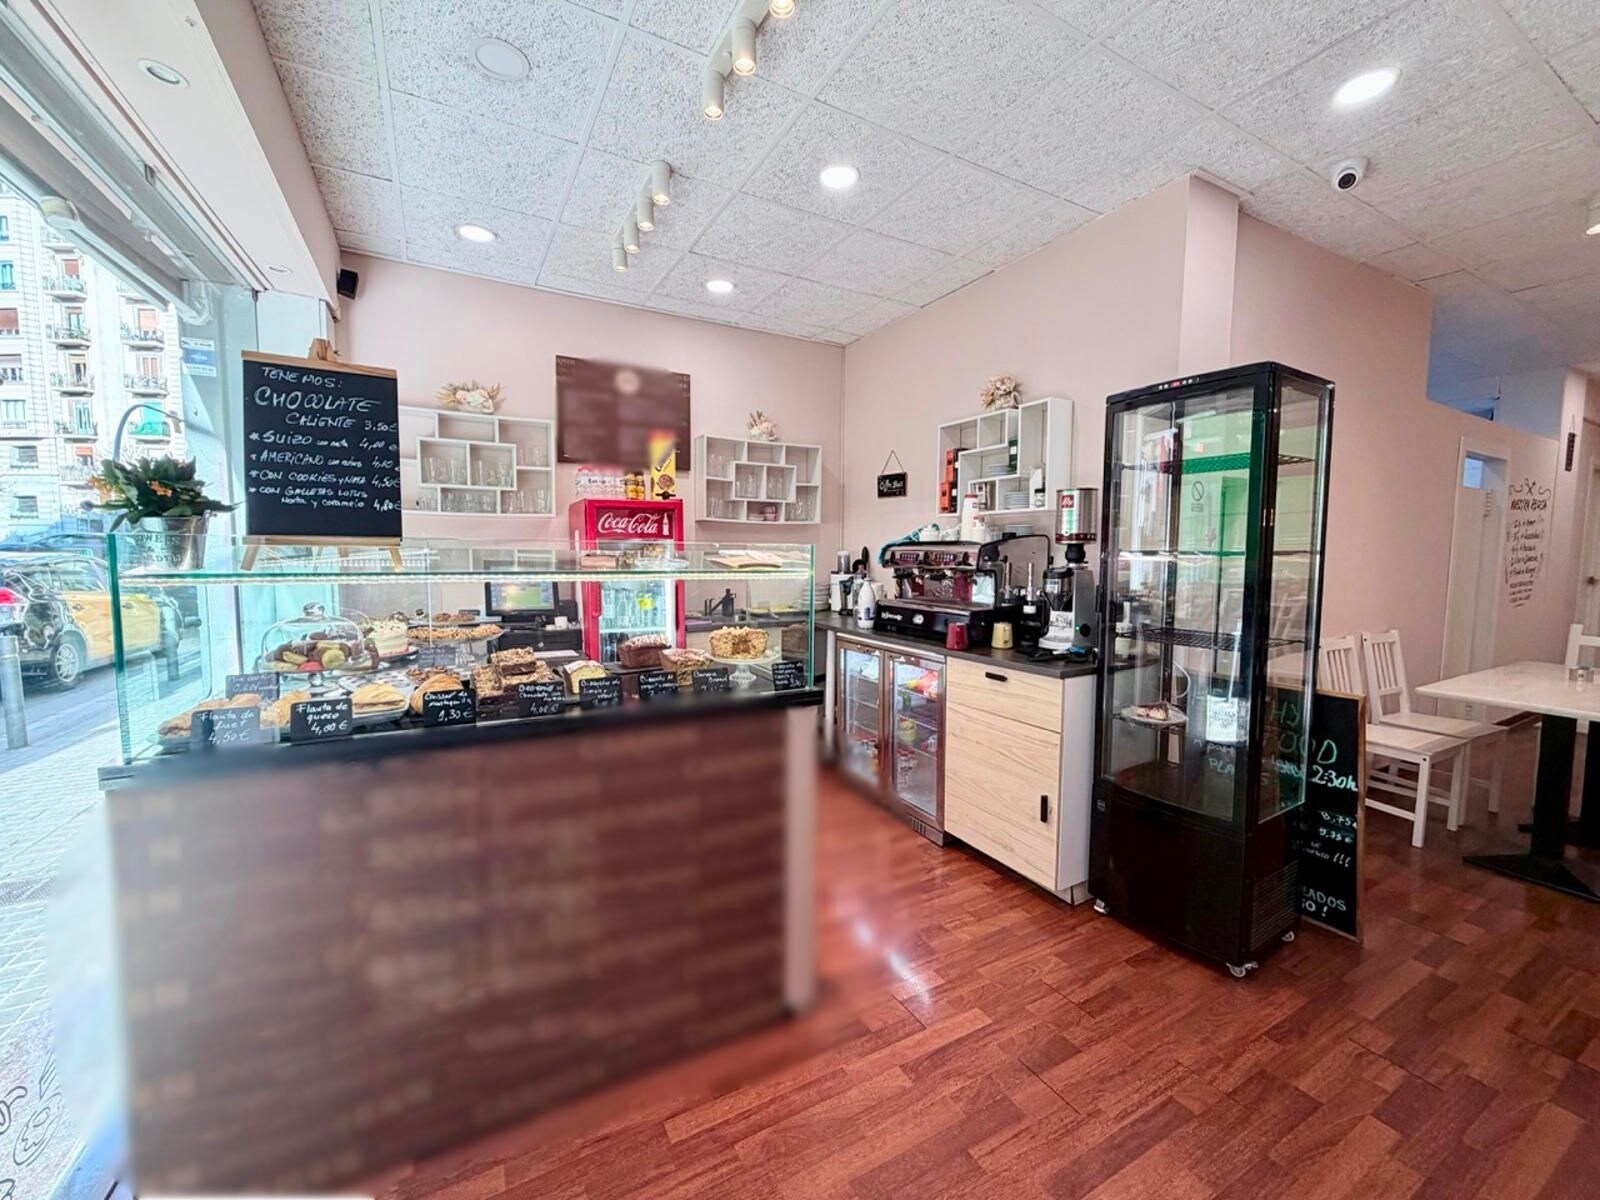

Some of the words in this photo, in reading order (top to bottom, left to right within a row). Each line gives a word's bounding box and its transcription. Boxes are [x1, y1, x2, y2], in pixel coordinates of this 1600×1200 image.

[254, 386, 381, 412] CHOCOLATE
[285, 412, 356, 428] CALIENTE
[263, 430, 313, 446] SUIZO
[260, 449, 324, 466] AMERICANO
[259, 469, 283, 481] CON
[288, 468, 337, 483] COOKIES
[259, 486, 281, 495] CON
[285, 486, 334, 497] GALLETAS
[295, 703, 331, 713] Flauta
[335, 702, 348, 710] de
